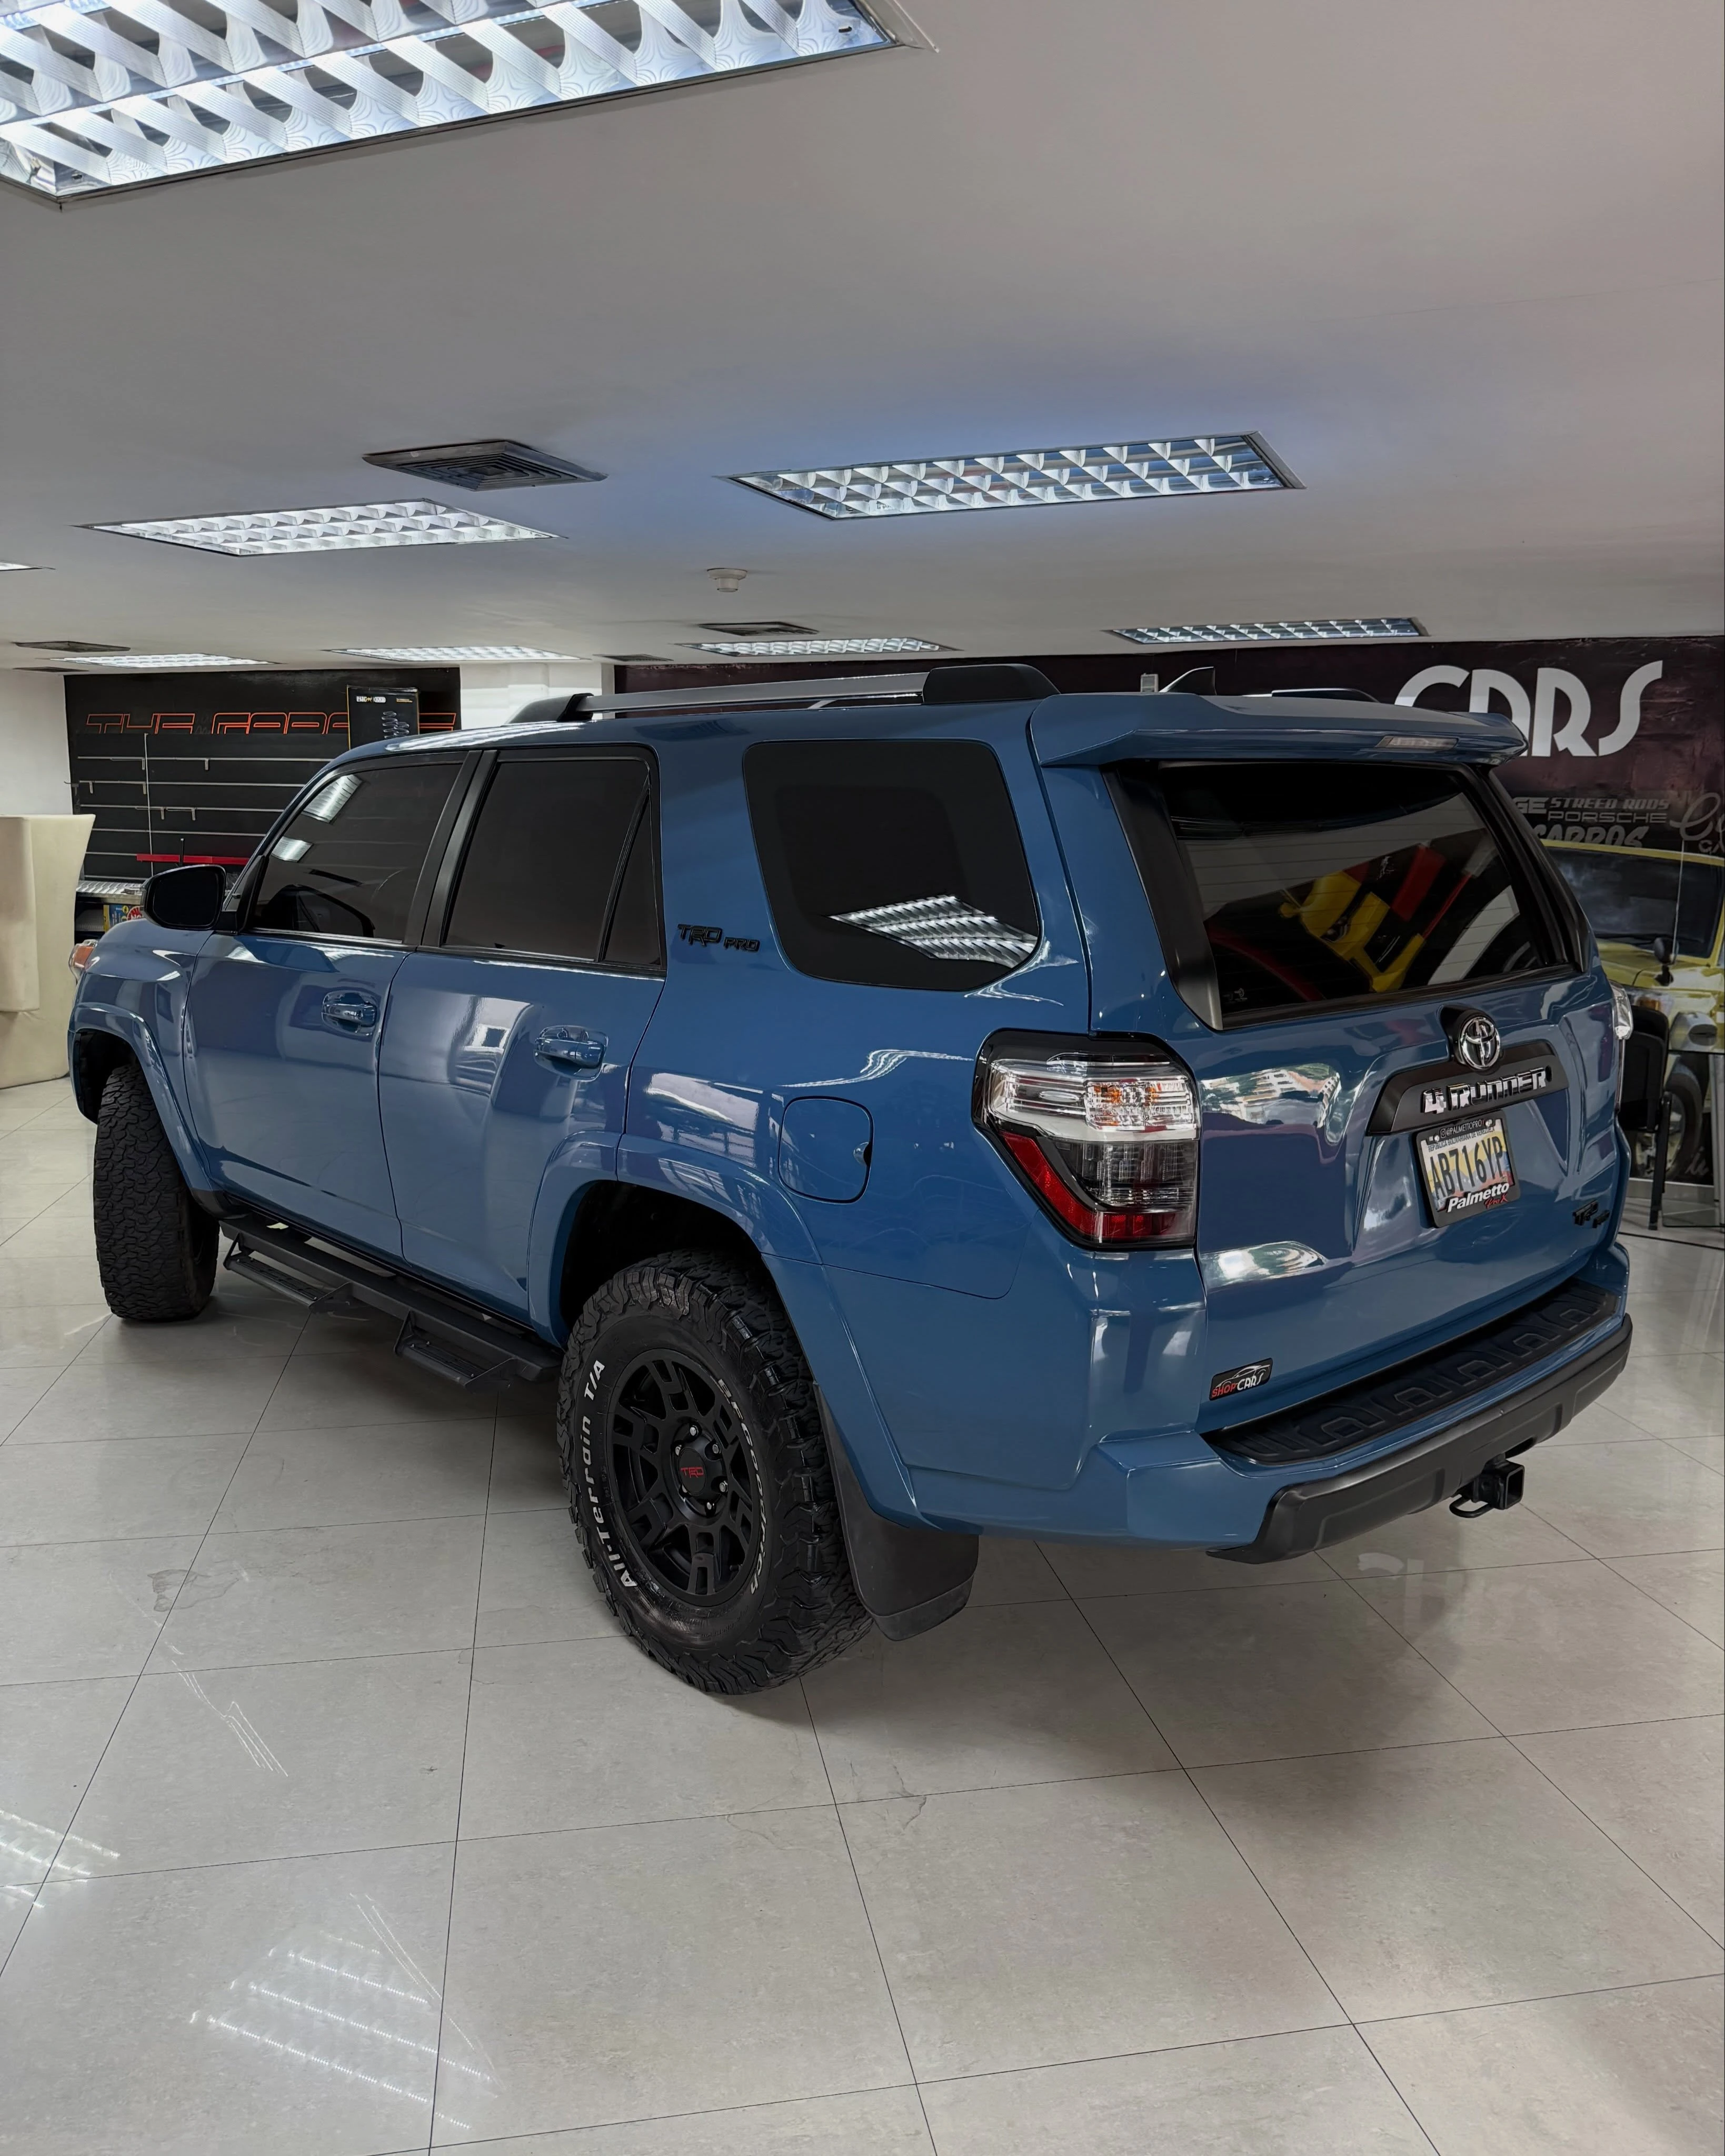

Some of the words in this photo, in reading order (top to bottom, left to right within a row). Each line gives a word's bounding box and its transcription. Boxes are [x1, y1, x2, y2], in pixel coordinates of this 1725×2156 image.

[1548, 810, 1668, 824] PORSCHE
[677, 924, 723, 947] TRD
[723, 936, 760, 952] PRO
[1430, 1136, 1504, 1201] AB716YP
[1447, 1183, 1509, 1213] Palmetto
[584, 1360, 605, 1401] T/A
[680, 1466, 704, 1479] TRD
